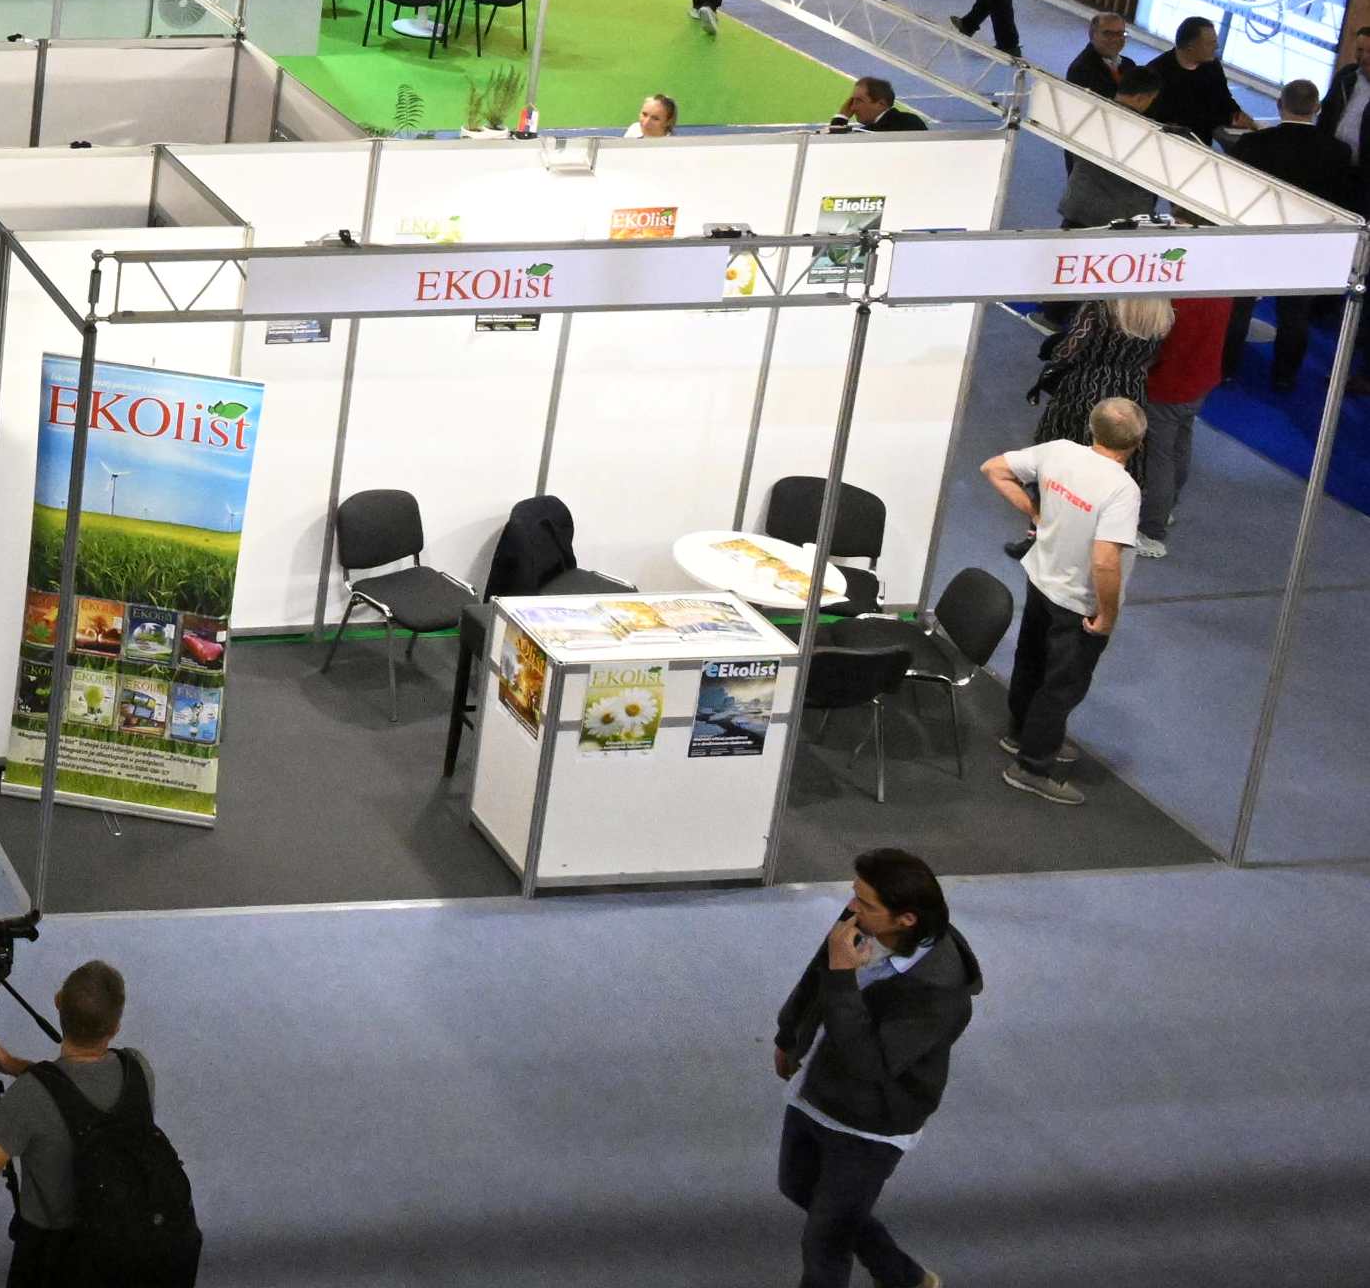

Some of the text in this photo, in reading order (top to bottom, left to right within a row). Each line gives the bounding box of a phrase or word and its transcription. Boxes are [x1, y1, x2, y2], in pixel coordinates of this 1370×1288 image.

[612, 210, 675, 228] EKOlist
[415, 267, 554, 302] EKOlist
[1052, 253, 1186, 286] EKOlist
[45, 384, 251, 450] EKOlist
